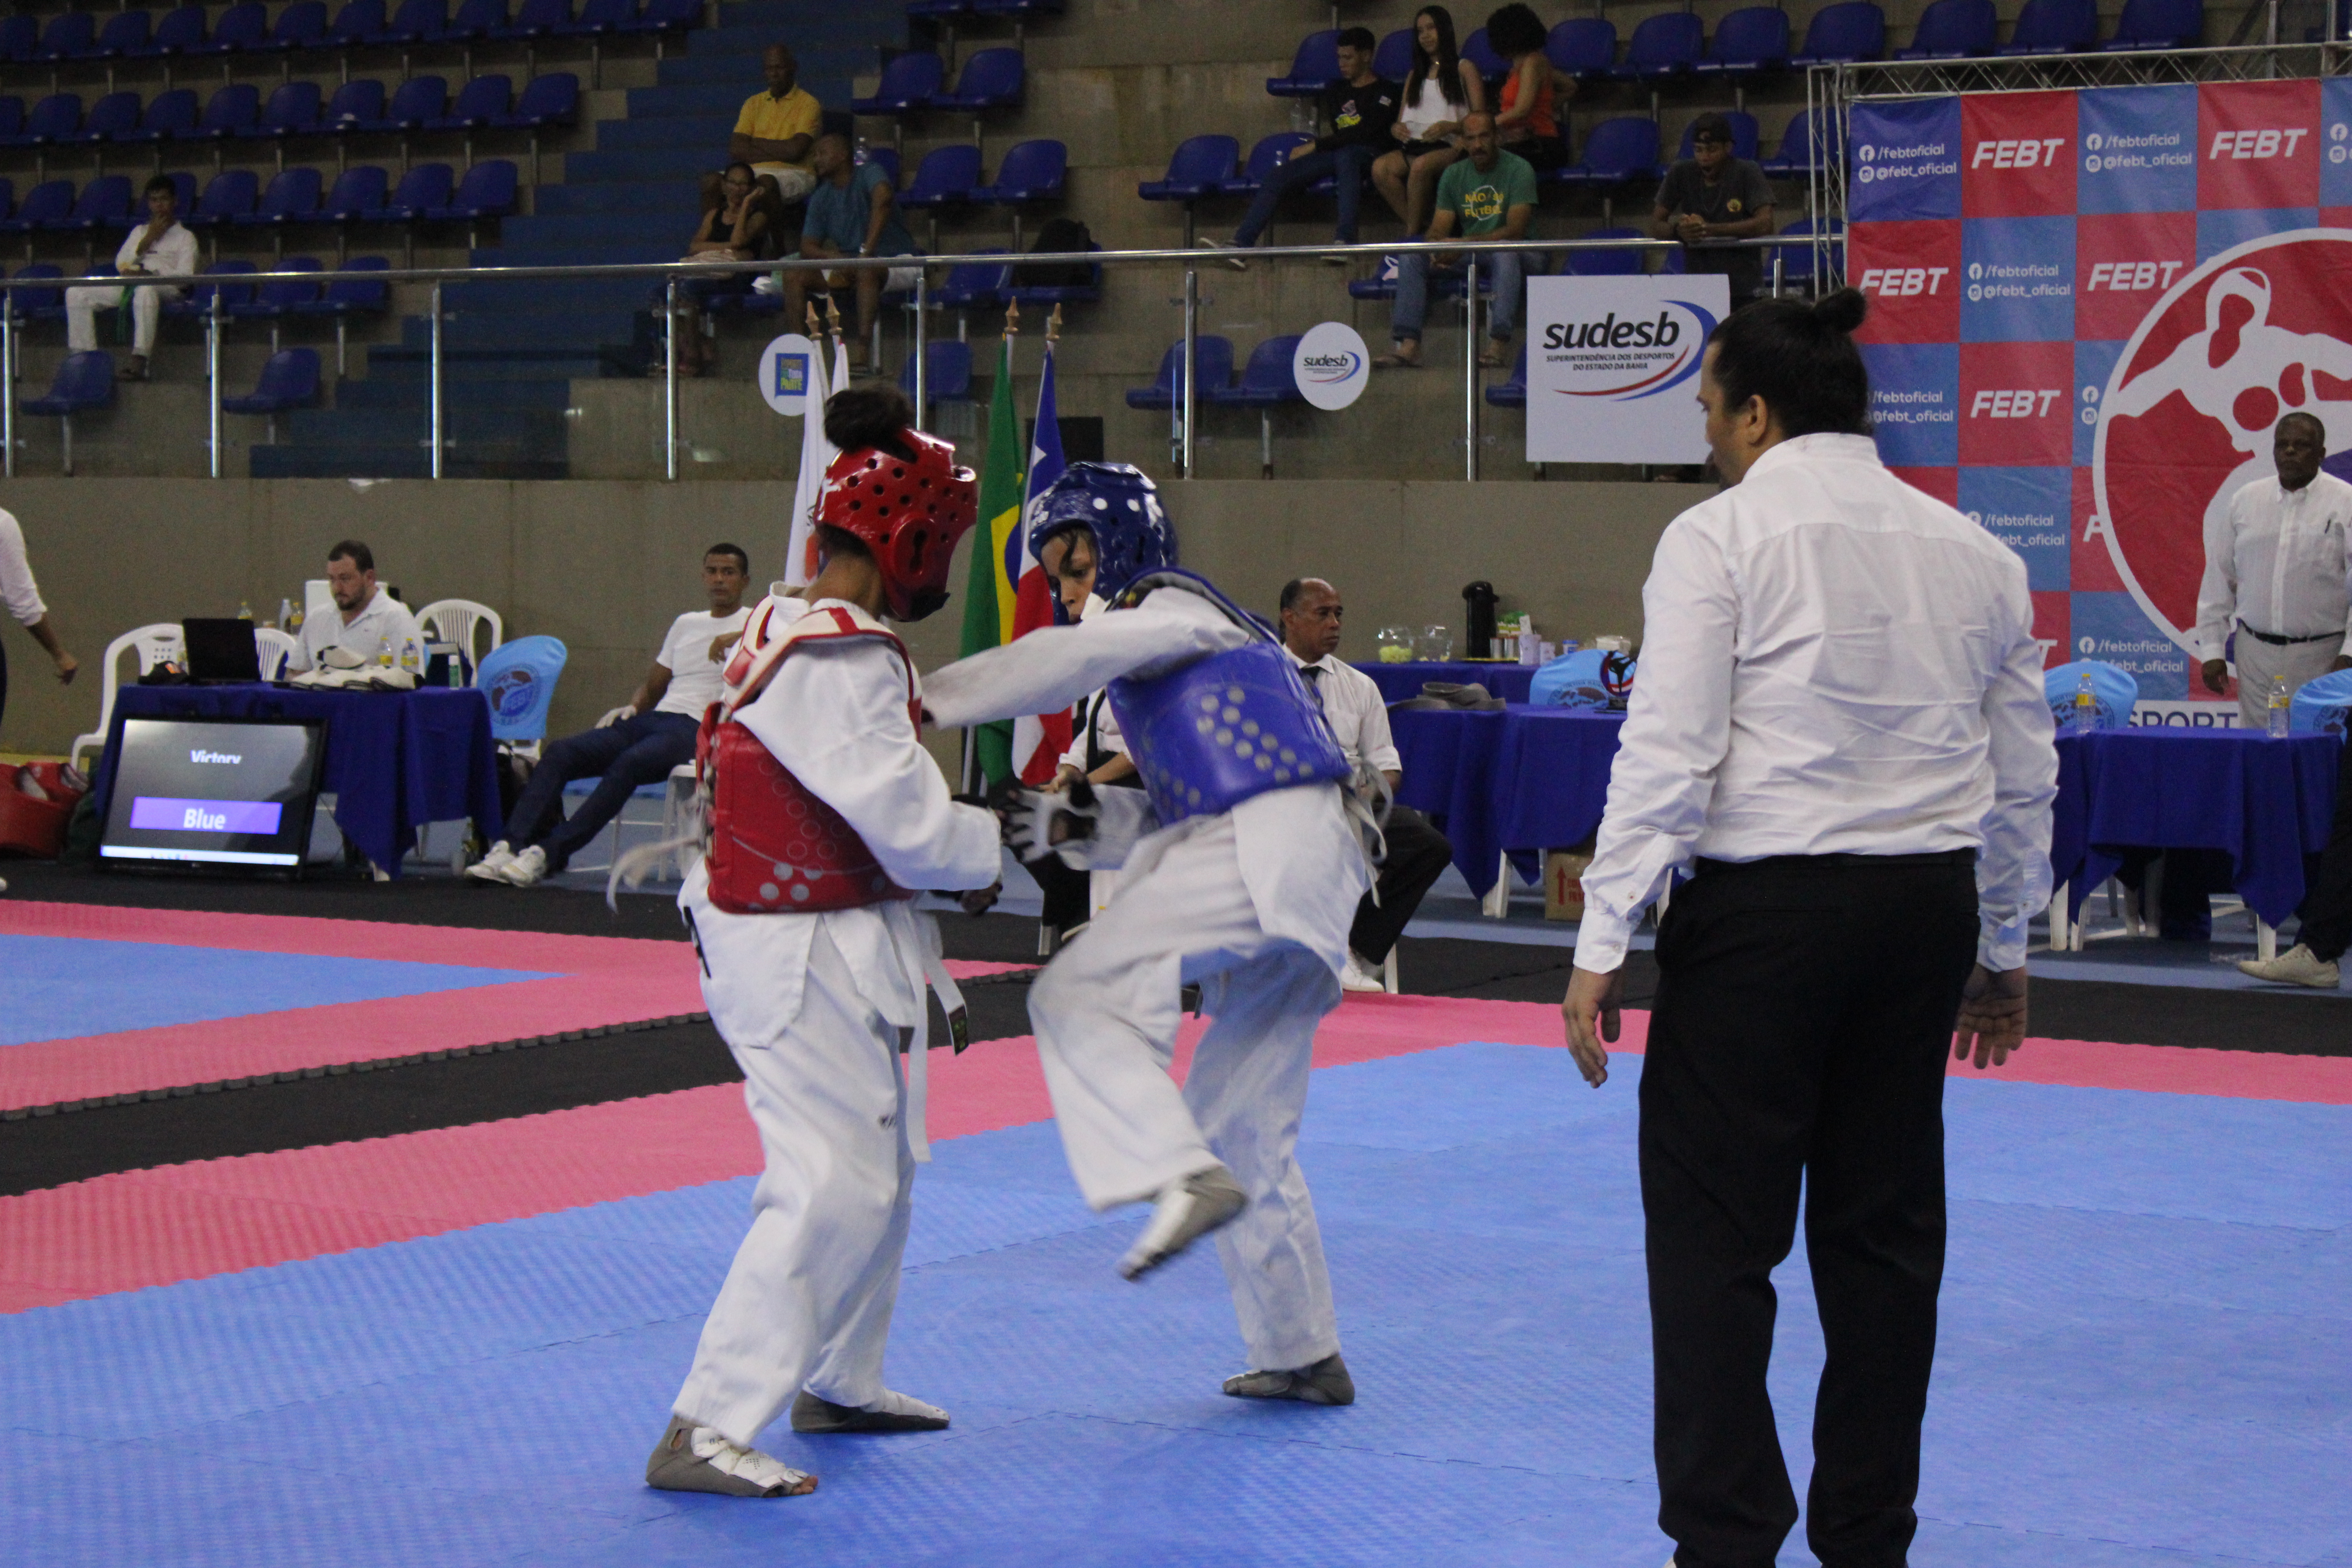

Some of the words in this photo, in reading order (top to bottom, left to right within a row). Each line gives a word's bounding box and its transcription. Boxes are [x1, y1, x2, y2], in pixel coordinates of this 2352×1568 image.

[2105, 133, 2180, 149] /febtoficial
[2209, 128, 2308, 160] FEBT
[1878, 143, 1944, 160] /febtoficial
[1971, 138, 2065, 169] FEBT
[2103, 152, 2192, 169] @febt_oficial
[1877, 162, 1957, 180] @febt_oficial
[1985, 264, 2059, 279] /febtoficial
[2087, 261, 2183, 291] FEBT
[1859, 267, 1949, 296] FEBT
[1984, 283, 2071, 299] @febt_oficial
[1543, 311, 1680, 350] sudesb
[1303, 354, 1348, 367] sudesb
[1634, 352, 1675, 360] DESPORTOS
[1872, 390, 1943, 404] /febtoficial
[1970, 390, 2062, 418] FEBT
[1984, 514, 2054, 530] /febtoficial
[2098, 639, 2172, 653] /febtoficial
[183, 808, 226, 830] Blue
